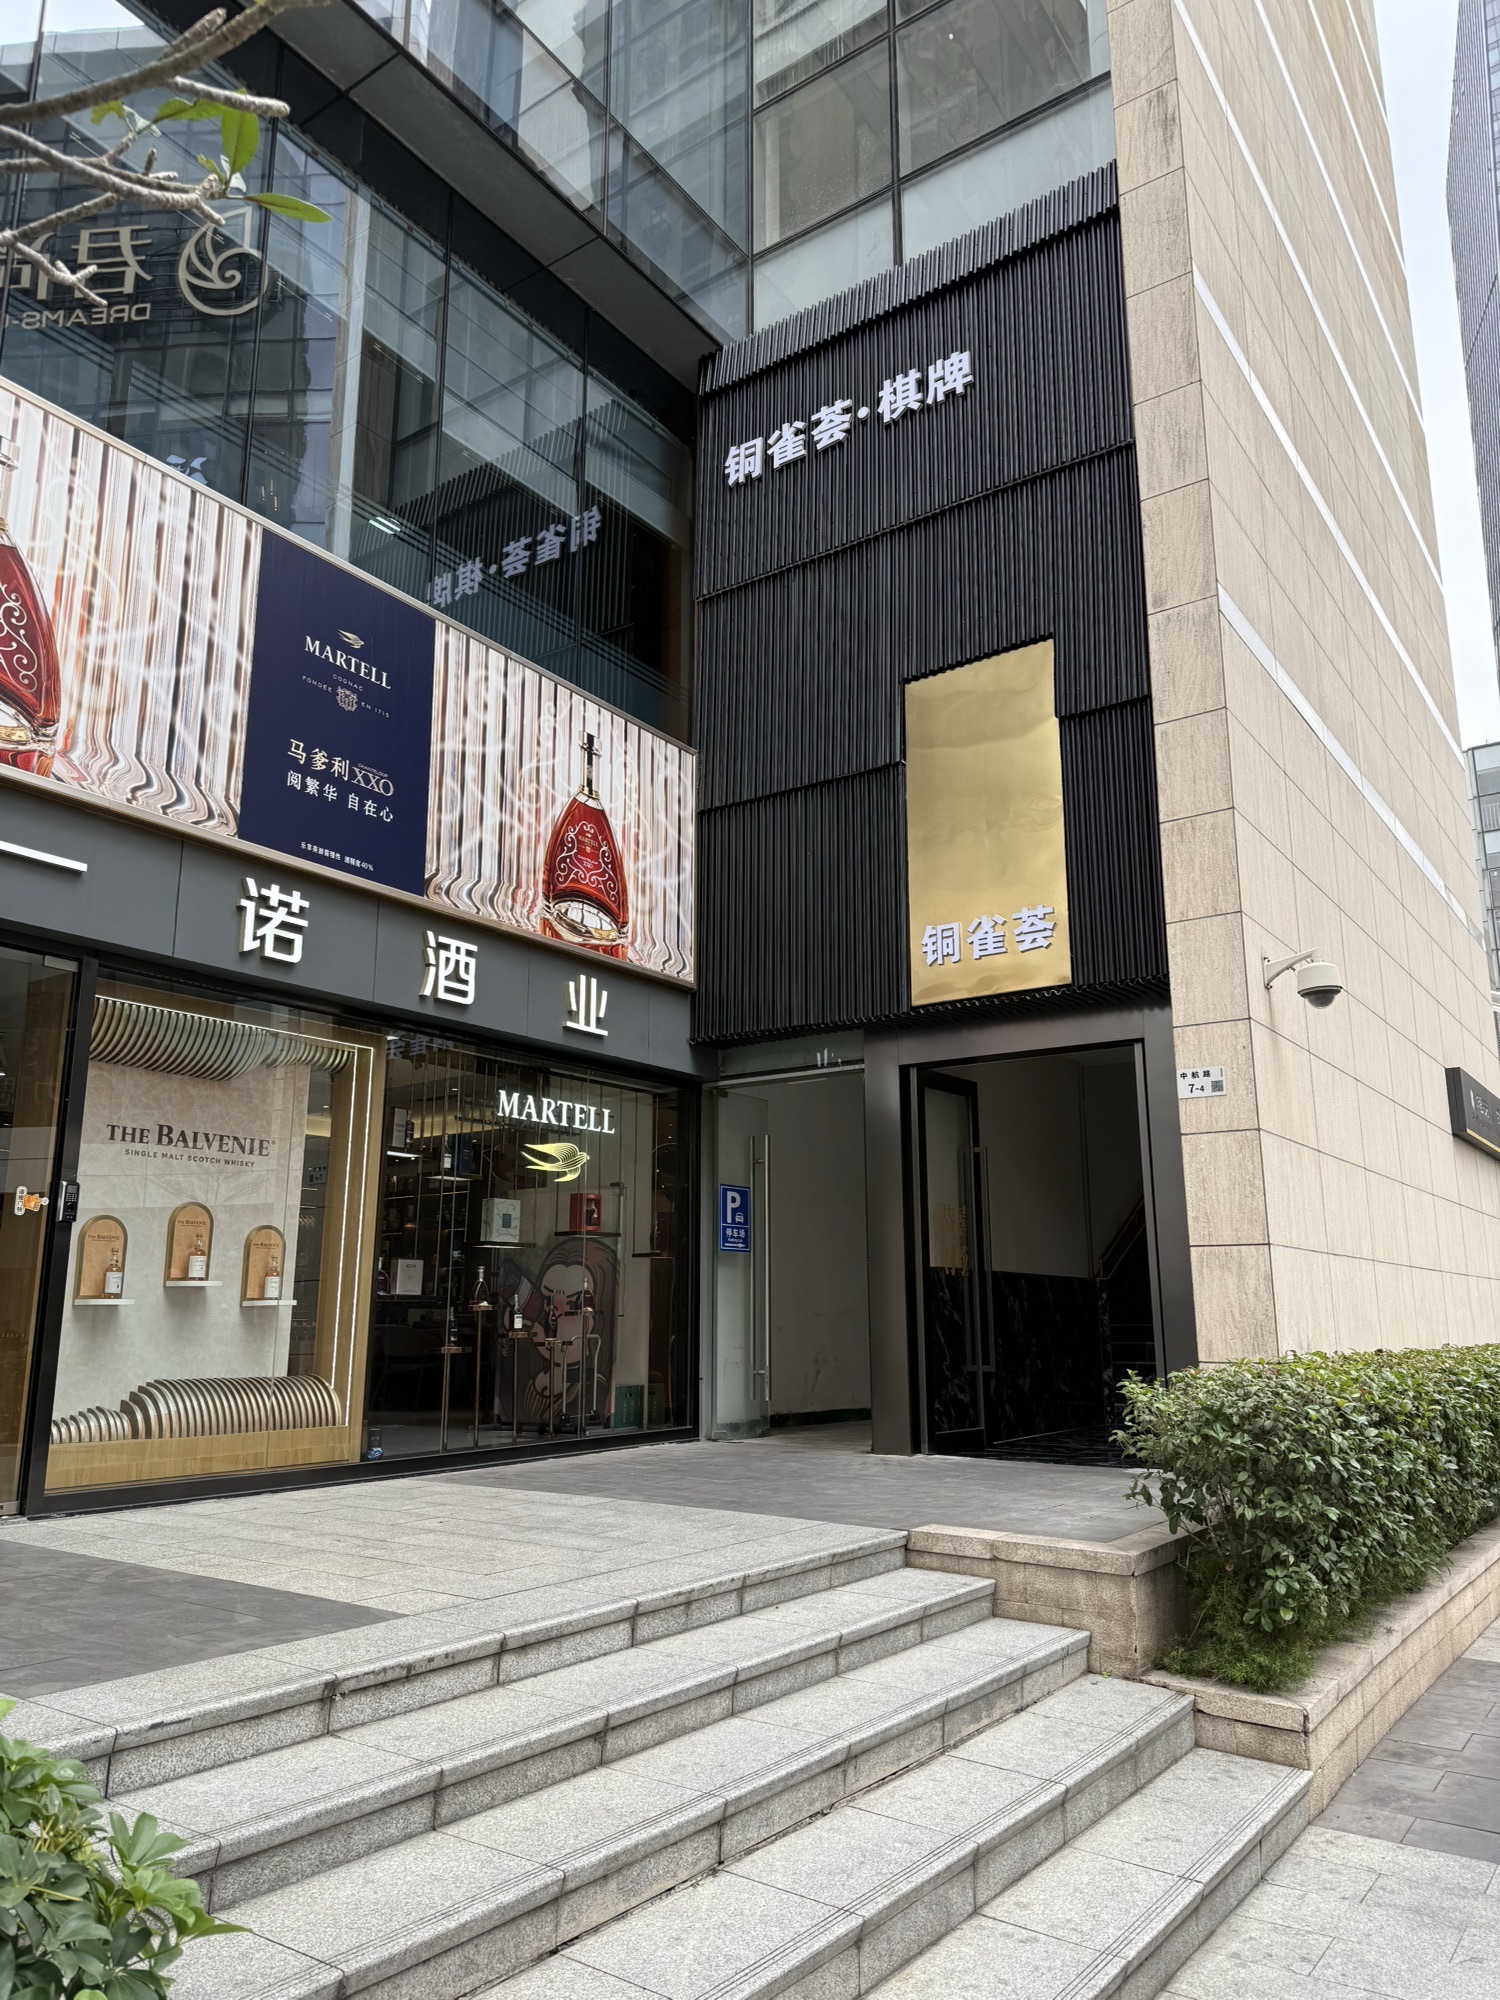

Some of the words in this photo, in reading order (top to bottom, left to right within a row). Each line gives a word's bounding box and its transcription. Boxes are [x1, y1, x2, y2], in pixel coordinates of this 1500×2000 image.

[305, 635, 391, 690] MARTELL
[332, 673, 364, 692] COGNAC
[361, 701, 372, 710] EN
[374, 706, 390, 718] 1715
[287, 738, 350, 782] 马爹利
[351, 766, 394, 797] XXO
[287, 770, 338, 802] 阅繁华
[347, 793, 394, 822] 自在心
[921, 904, 1057, 967] 铜雀荟
[1188, 1083, 1205, 1093] 7-4
[498, 1089, 616, 1134] MARTELL
[106, 1124, 151, 1144] THE
[155, 1123, 270, 1157] BALVENIE
[125, 1149, 158, 1159] SINGLE
[161, 1152, 185, 1161] MALT
[187, 1155, 221, 1165] SCOTCH
[224, 1158, 256, 1168] WHISKY
[725, 1227, 746, 1239] 停车场
